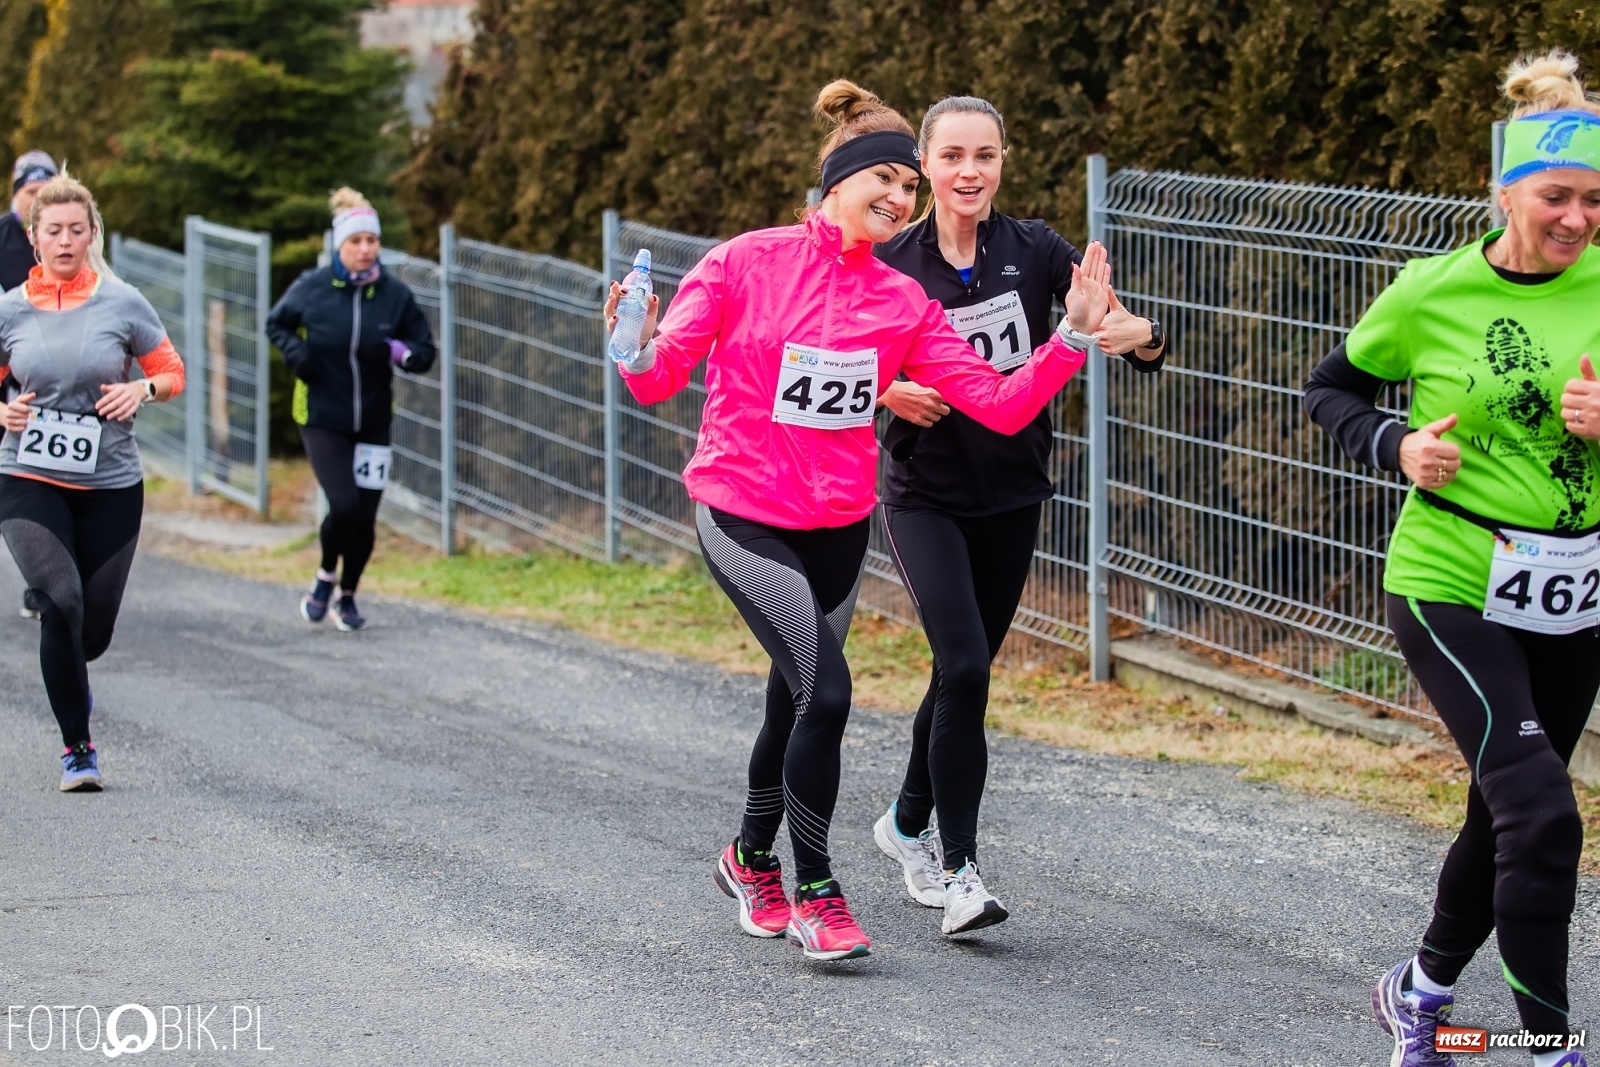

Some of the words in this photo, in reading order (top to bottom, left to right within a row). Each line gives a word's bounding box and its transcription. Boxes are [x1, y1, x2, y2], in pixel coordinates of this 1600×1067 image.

[958, 300, 1018, 323] www.personalbest.pl
[781, 375, 873, 415] 425
[24, 429, 93, 462] 269
[357, 461, 385, 479] 41
[1494, 568, 1600, 617] 462
